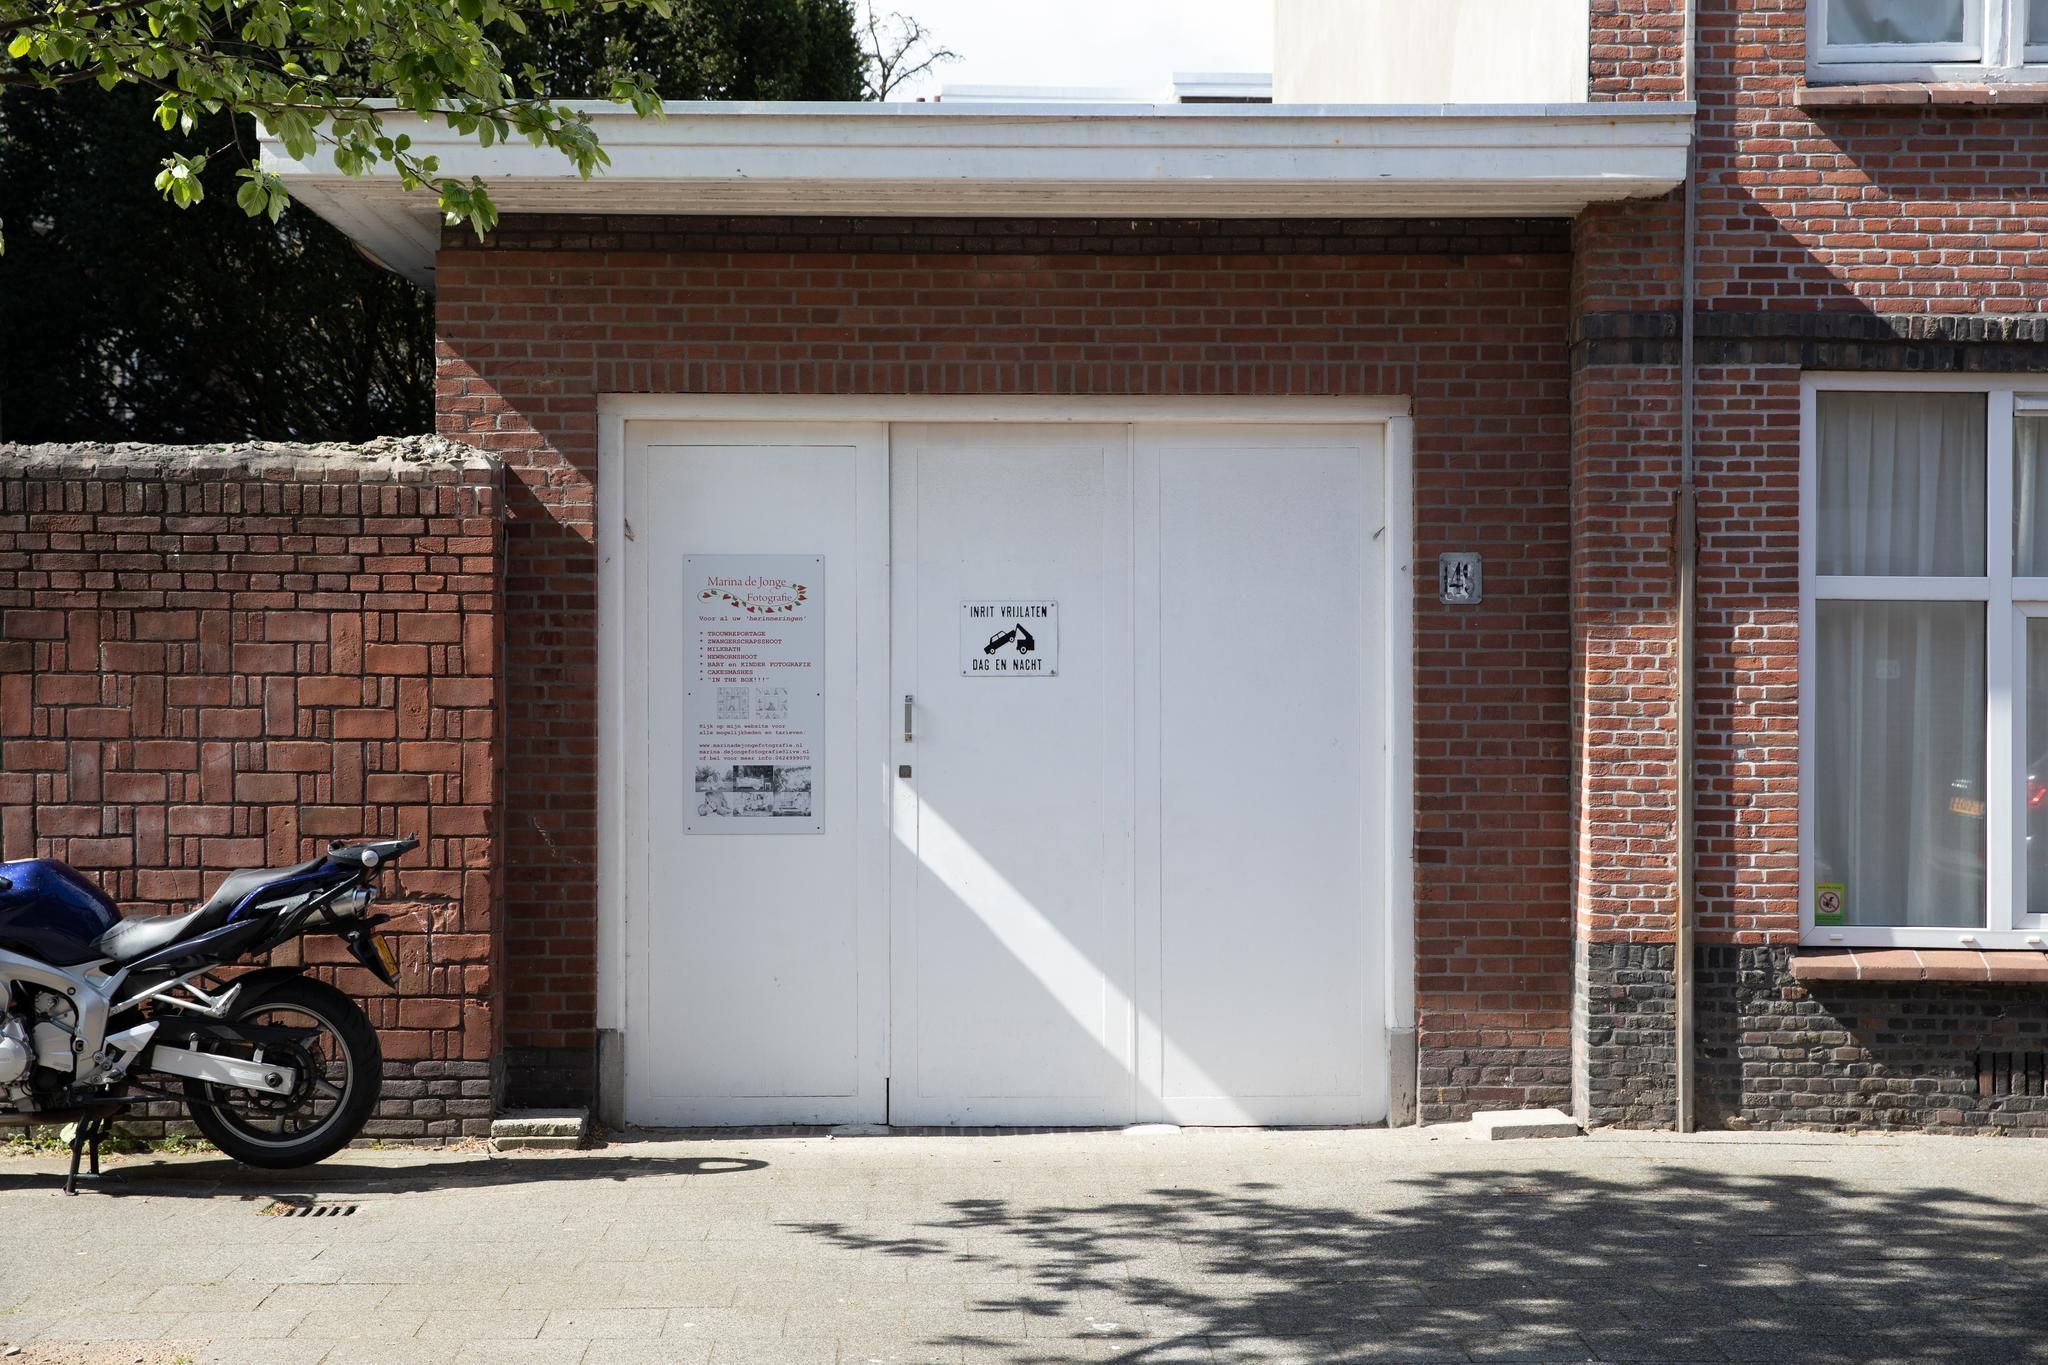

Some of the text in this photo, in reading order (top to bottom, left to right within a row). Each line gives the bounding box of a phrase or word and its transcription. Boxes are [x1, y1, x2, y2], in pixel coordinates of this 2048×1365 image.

[707, 576, 787, 589] Marina de Jonge
[747, 593, 793, 604] Fotografie
[970, 606, 1048, 618] INRIT VRIJLATEN
[972, 659, 1042, 671] DAG EN NACHT
